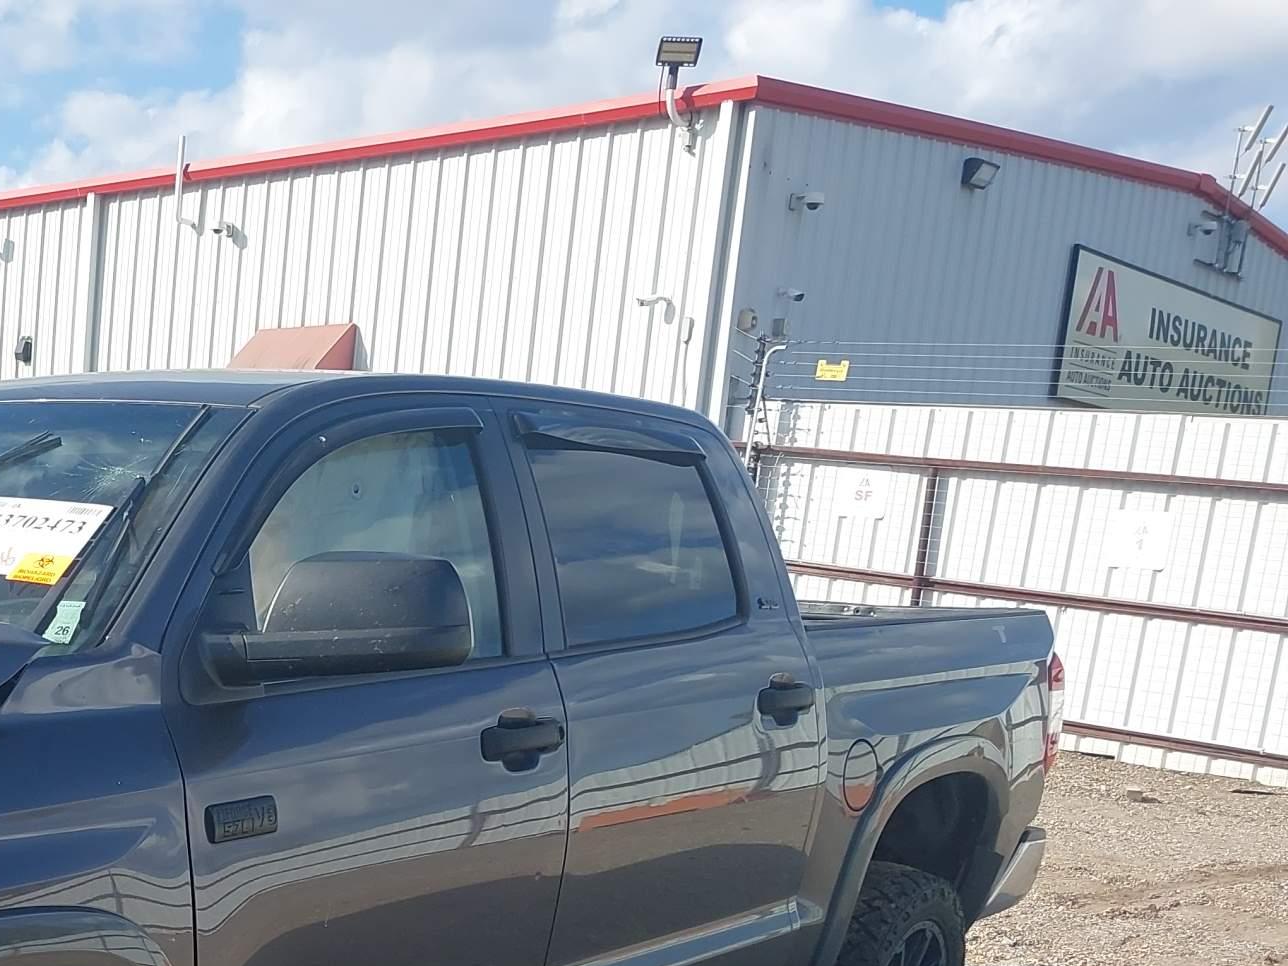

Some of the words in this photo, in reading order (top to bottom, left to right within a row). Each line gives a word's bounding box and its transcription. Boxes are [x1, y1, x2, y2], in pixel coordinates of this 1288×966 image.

[1071, 346, 1115, 370] INSURANCE
[1148, 307, 1253, 371] INSURANCE
[1117, 350, 1174, 394] AUTO
[1176, 368, 1263, 415] AUCTIONS
[54, 625, 71, 636] 26
